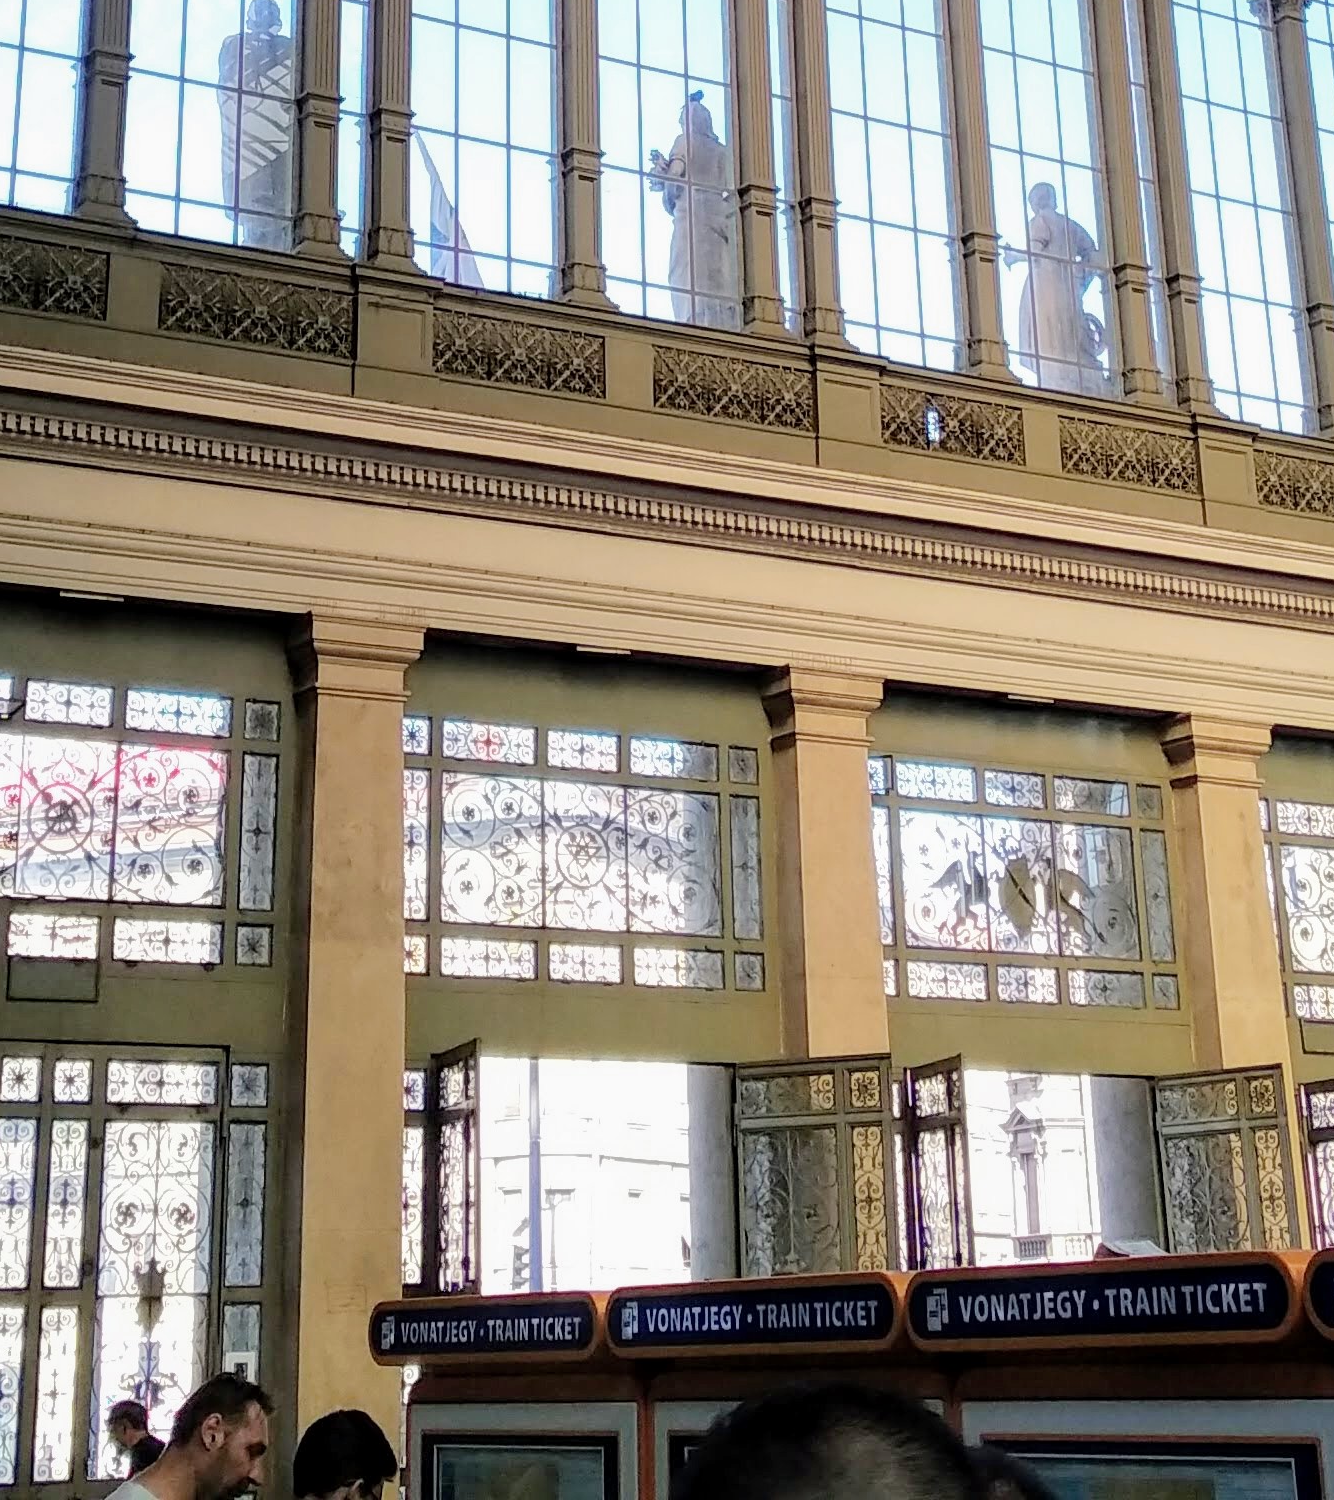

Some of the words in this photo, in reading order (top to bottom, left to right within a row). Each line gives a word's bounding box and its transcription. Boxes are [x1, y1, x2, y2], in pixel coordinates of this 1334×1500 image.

[645, 1304, 743, 1333] VONATJEGY
[756, 1302, 810, 1330] TRAIN
[814, 1300, 879, 1328] TICKET
[958, 1290, 1086, 1324] VONATJEGY
[1104, 1286, 1177, 1317] TRAIN
[1181, 1282, 1268, 1315] TICKET
[400, 1319, 477, 1344] VONATJEGY
[487, 1318, 529, 1342] TRAIN
[532, 1316, 582, 1342] TICKET
